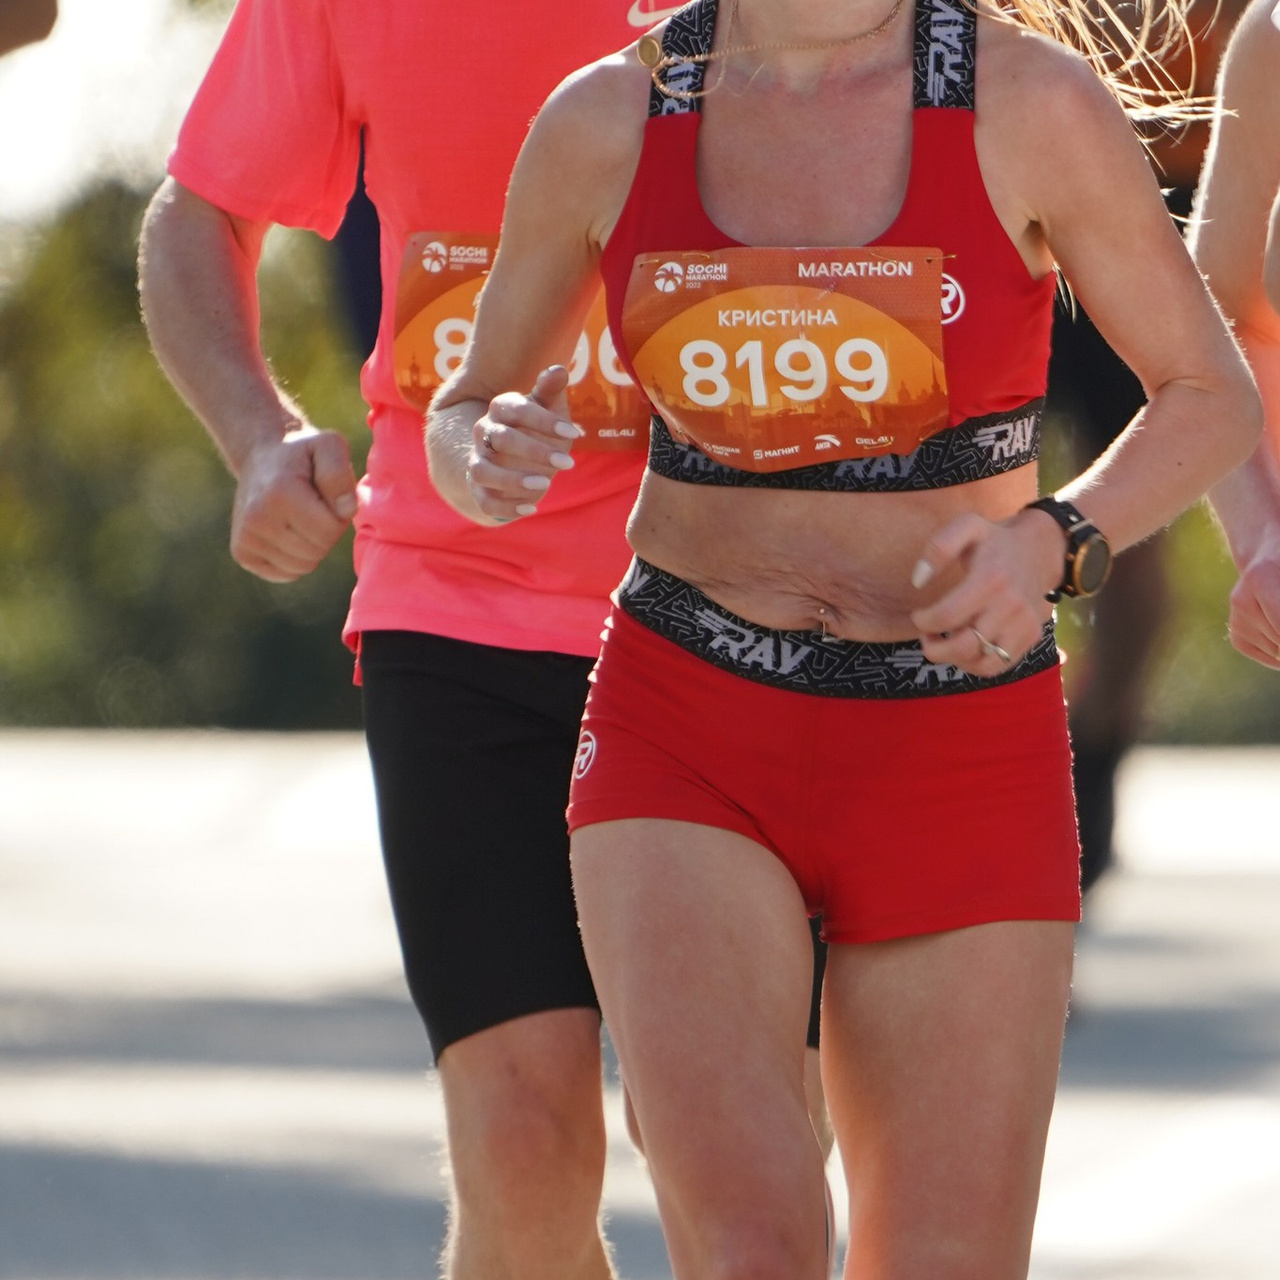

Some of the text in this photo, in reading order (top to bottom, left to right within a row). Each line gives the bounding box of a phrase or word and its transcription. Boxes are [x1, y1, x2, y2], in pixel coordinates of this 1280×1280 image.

[450, 246, 488, 257] SOCHI
[685, 273, 727, 281] MARATHON
[687, 263, 727, 274] SOCHI
[798, 261, 913, 278] MARATHON
[718, 308, 838, 327] КРИСТИНА
[679, 337, 889, 407] 8199
[973, 415, 1036, 461] RAY
[764, 444, 800, 459] МАГНИТ
[696, 610, 808, 675] RAY
